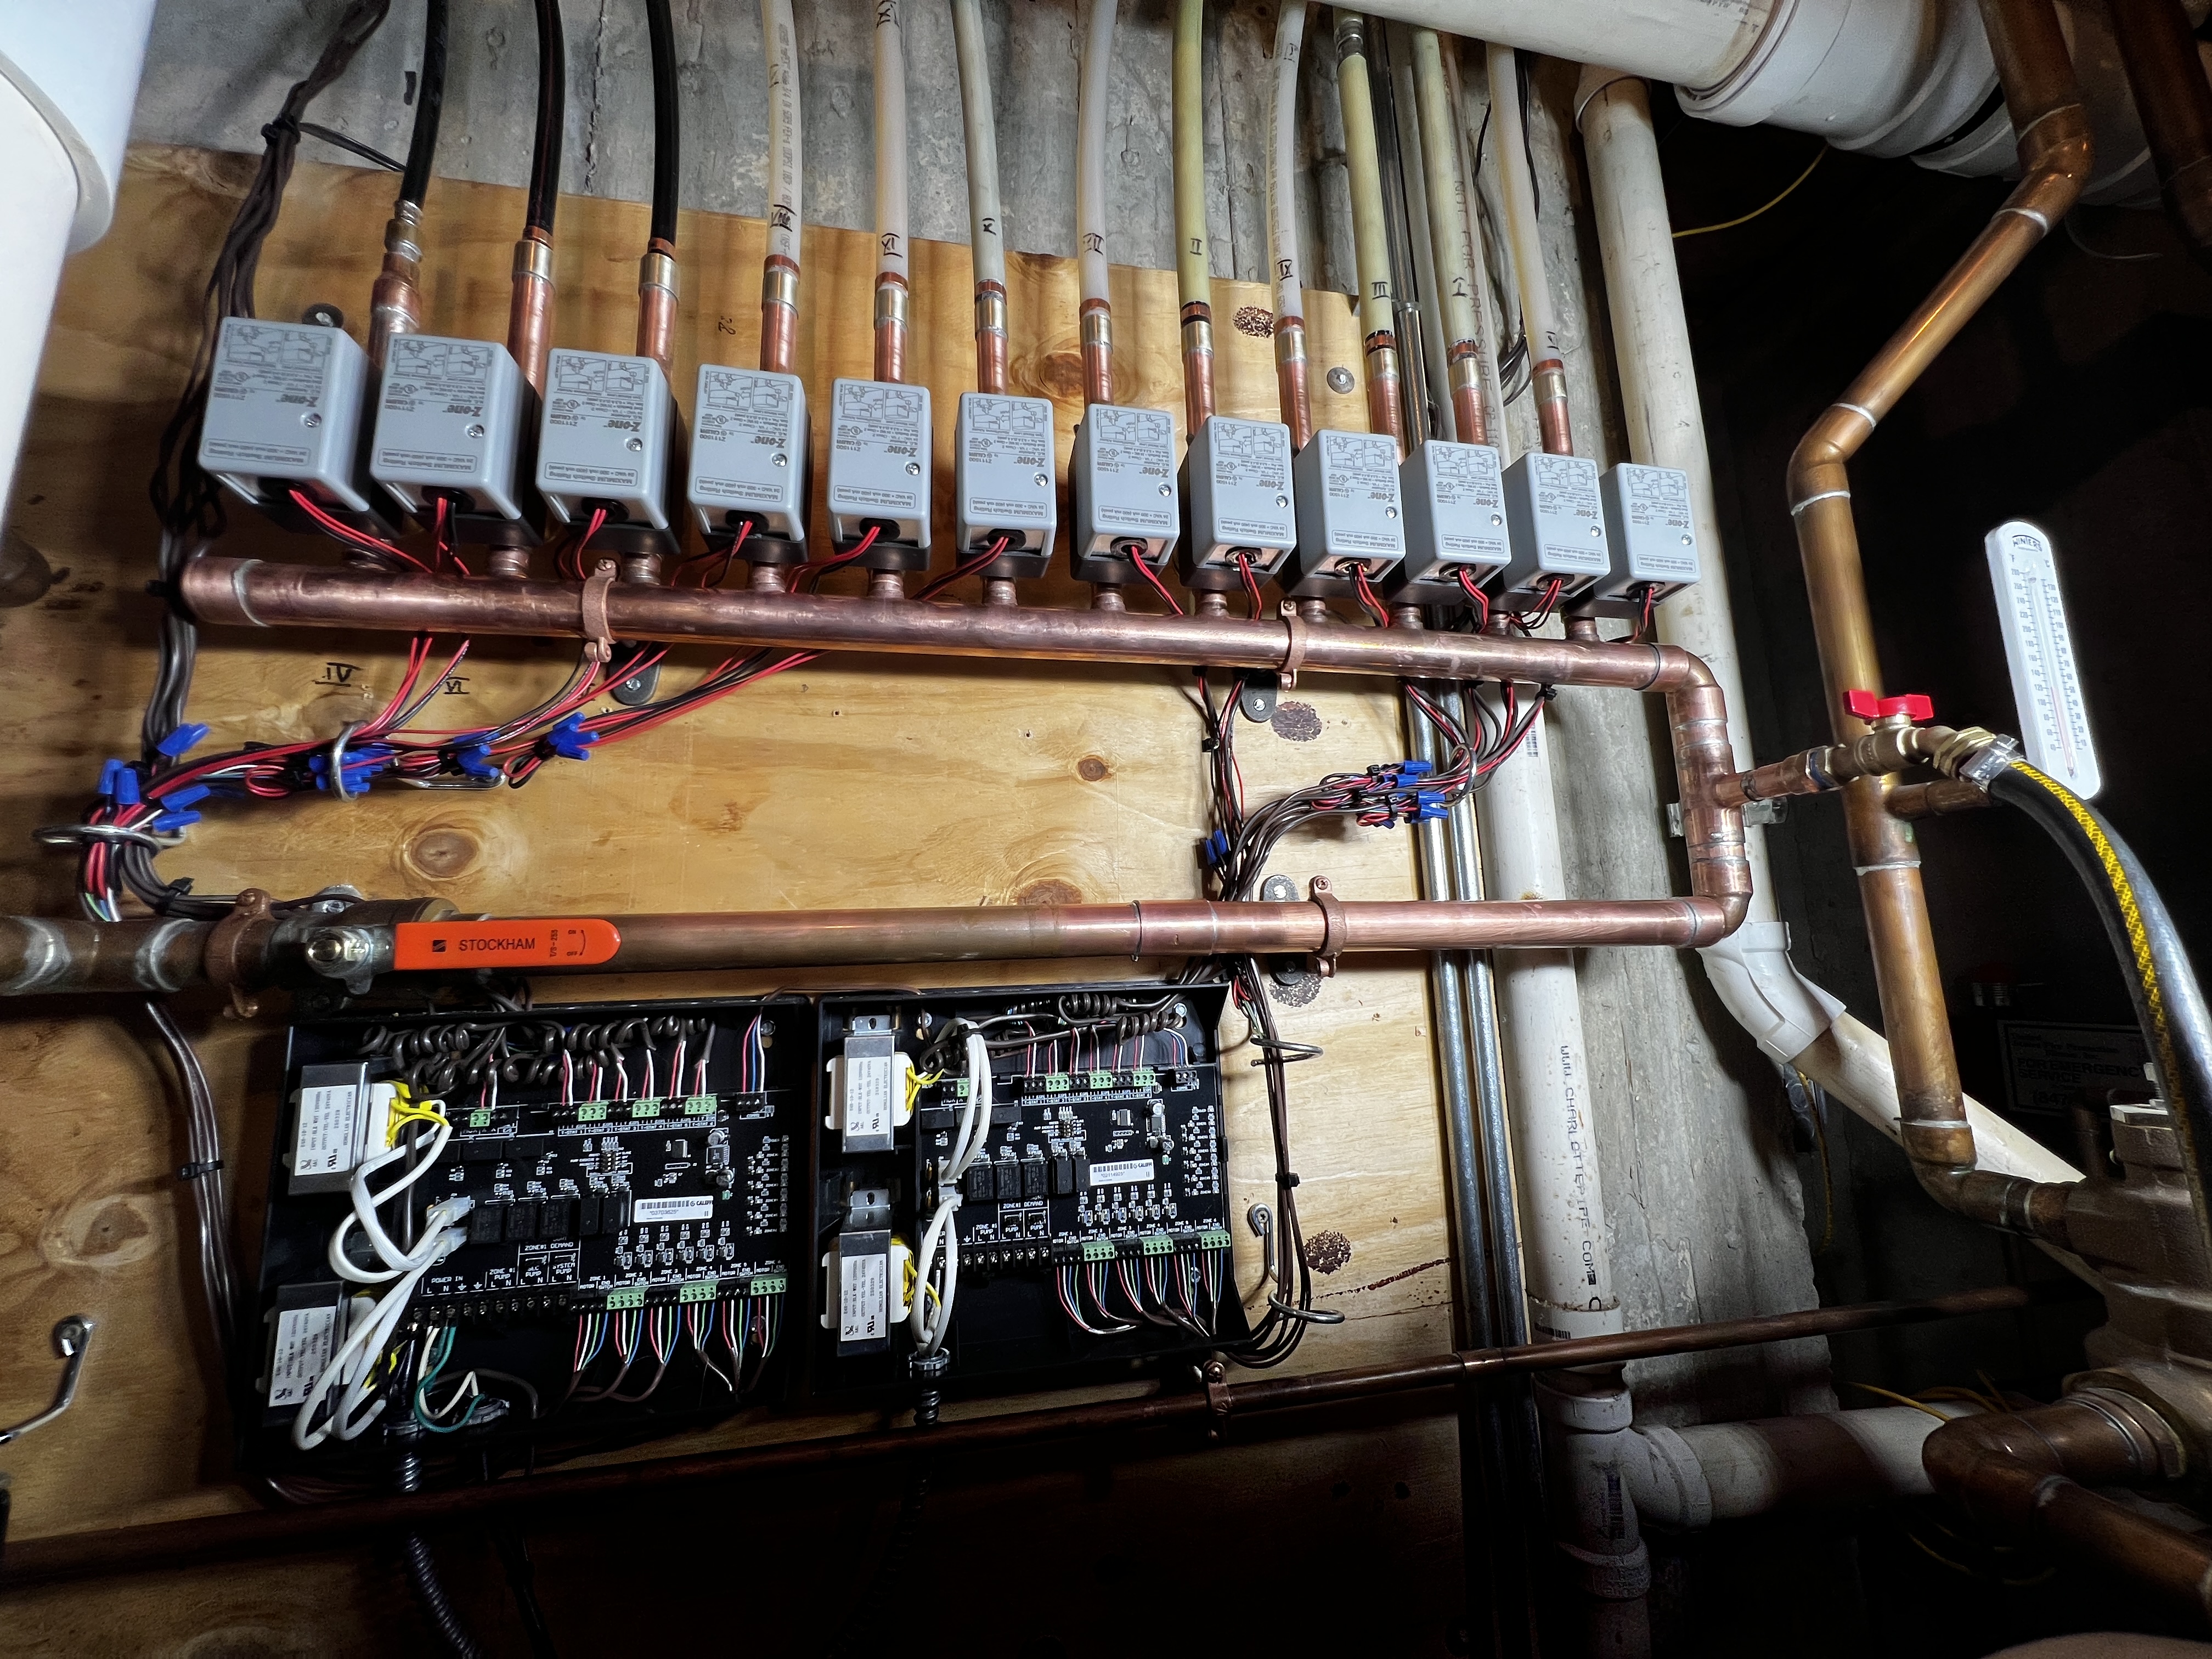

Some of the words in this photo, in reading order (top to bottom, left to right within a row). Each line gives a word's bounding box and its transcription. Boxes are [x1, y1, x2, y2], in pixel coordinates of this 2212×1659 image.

[2012, 537, 2042, 551] WINTERS
[459, 938, 535, 951] STOCKHAM
[2019, 1069, 2081, 1083] SERVICE
